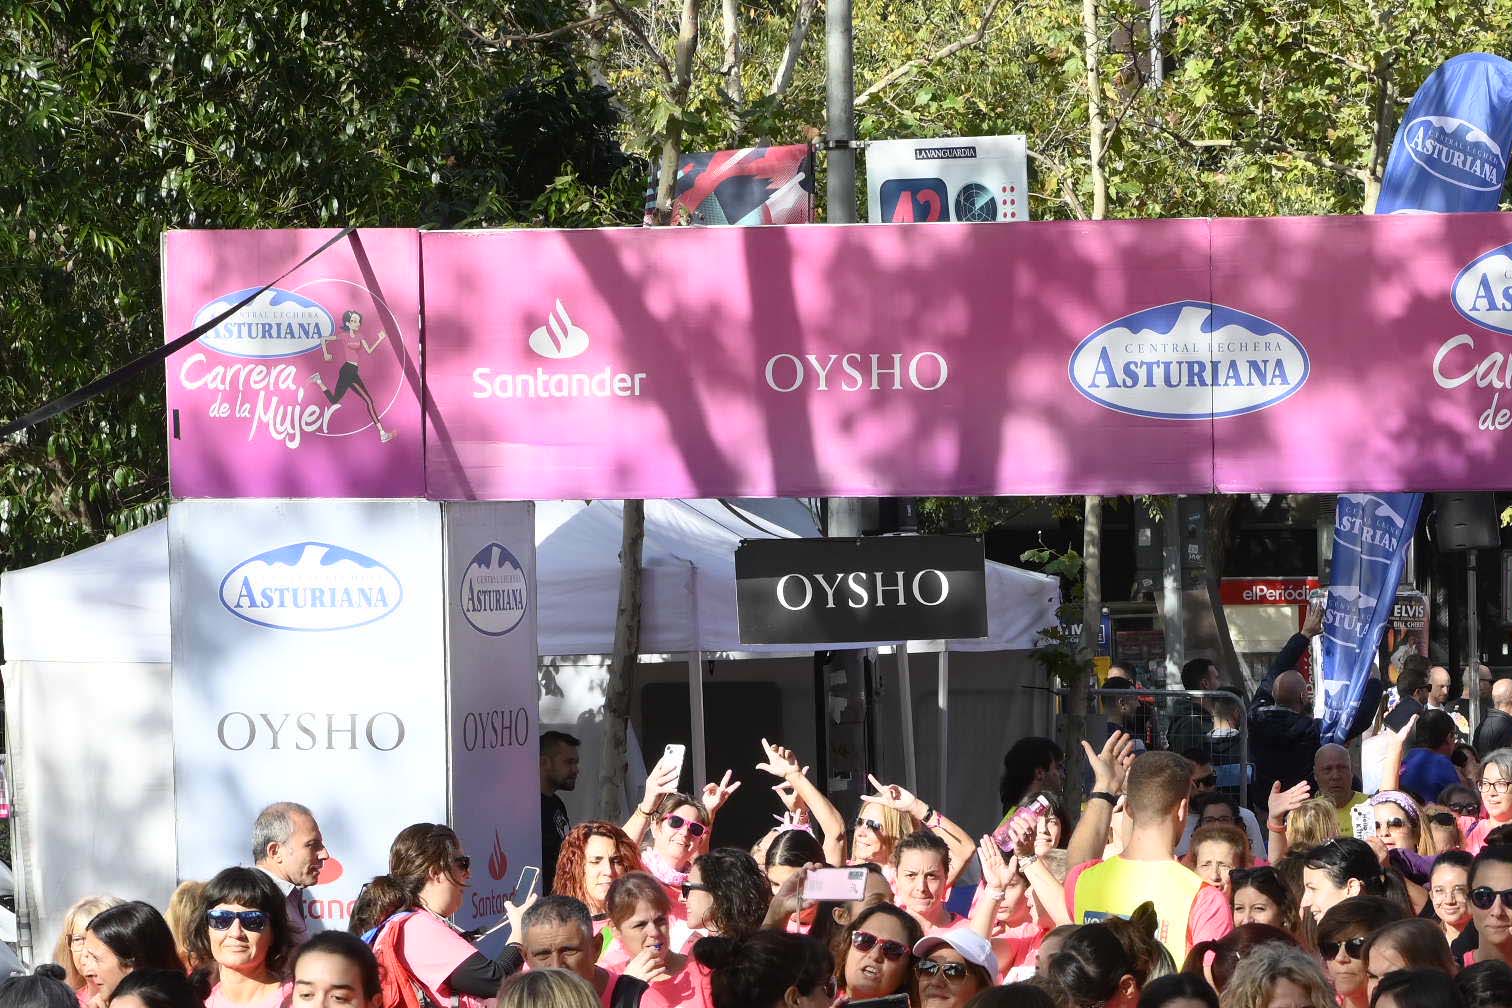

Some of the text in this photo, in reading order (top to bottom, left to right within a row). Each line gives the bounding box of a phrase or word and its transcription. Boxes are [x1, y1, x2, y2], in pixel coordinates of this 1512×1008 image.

[1410, 126, 1497, 185] ASTURIANA
[1124, 340, 1199, 354] CENTRAL
[179, 352, 298, 391] Carrera
[472, 366, 647, 399] Santander
[765, 351, 948, 393] OYSHO
[1088, 344, 1290, 392] ASTURIANA
[209, 387, 342, 449] de la Mujer
[1479, 393, 1511, 431] de
[234, 575, 389, 609] ASTURIANA
[466, 577, 524, 612] ASTURIANA
[776, 568, 951, 612] OYSHO
[1393, 604, 1424, 618] ELVIS
[217, 711, 406, 752] OYSHO
[463, 707, 529, 752] OYSHO
